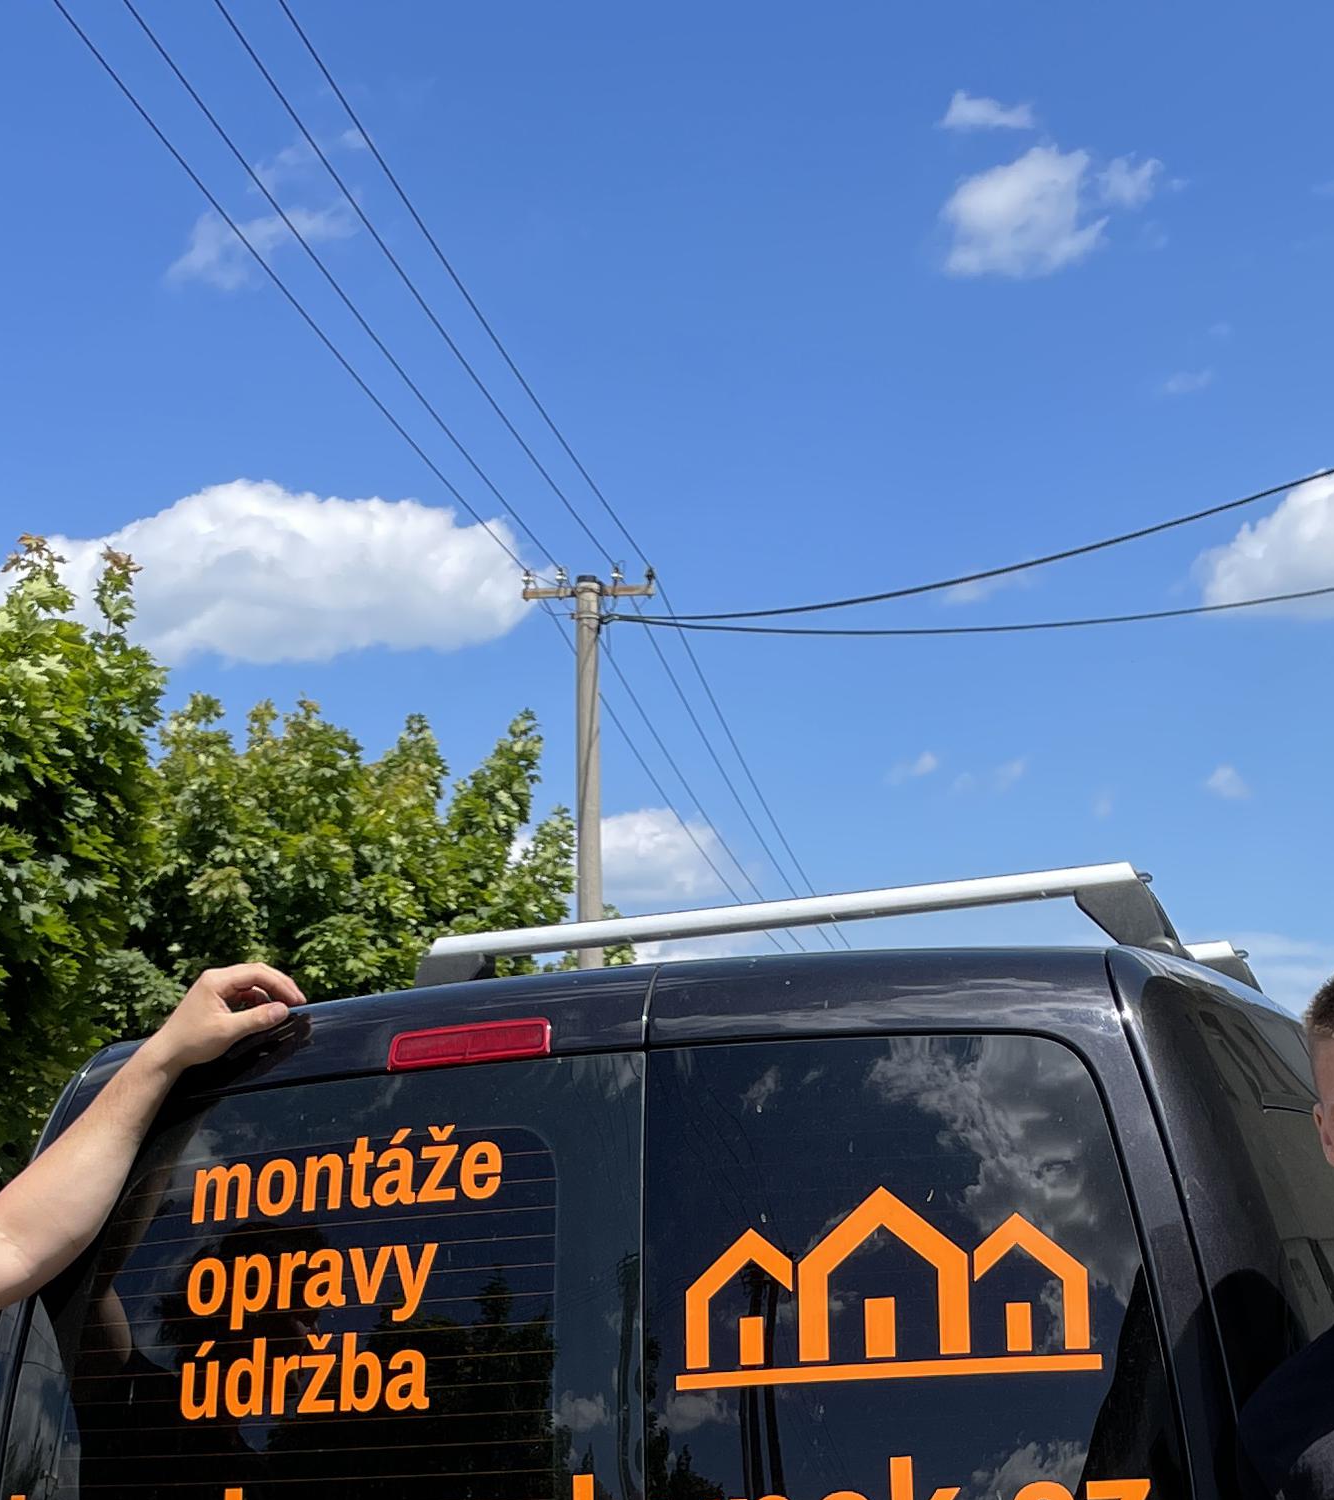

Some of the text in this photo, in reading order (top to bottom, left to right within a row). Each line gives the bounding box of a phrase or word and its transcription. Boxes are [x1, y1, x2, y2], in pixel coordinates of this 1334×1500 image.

[192, 1124, 502, 1223] montáže
[187, 1243, 438, 1330] opravy
[181, 1332, 430, 1420] údržba
